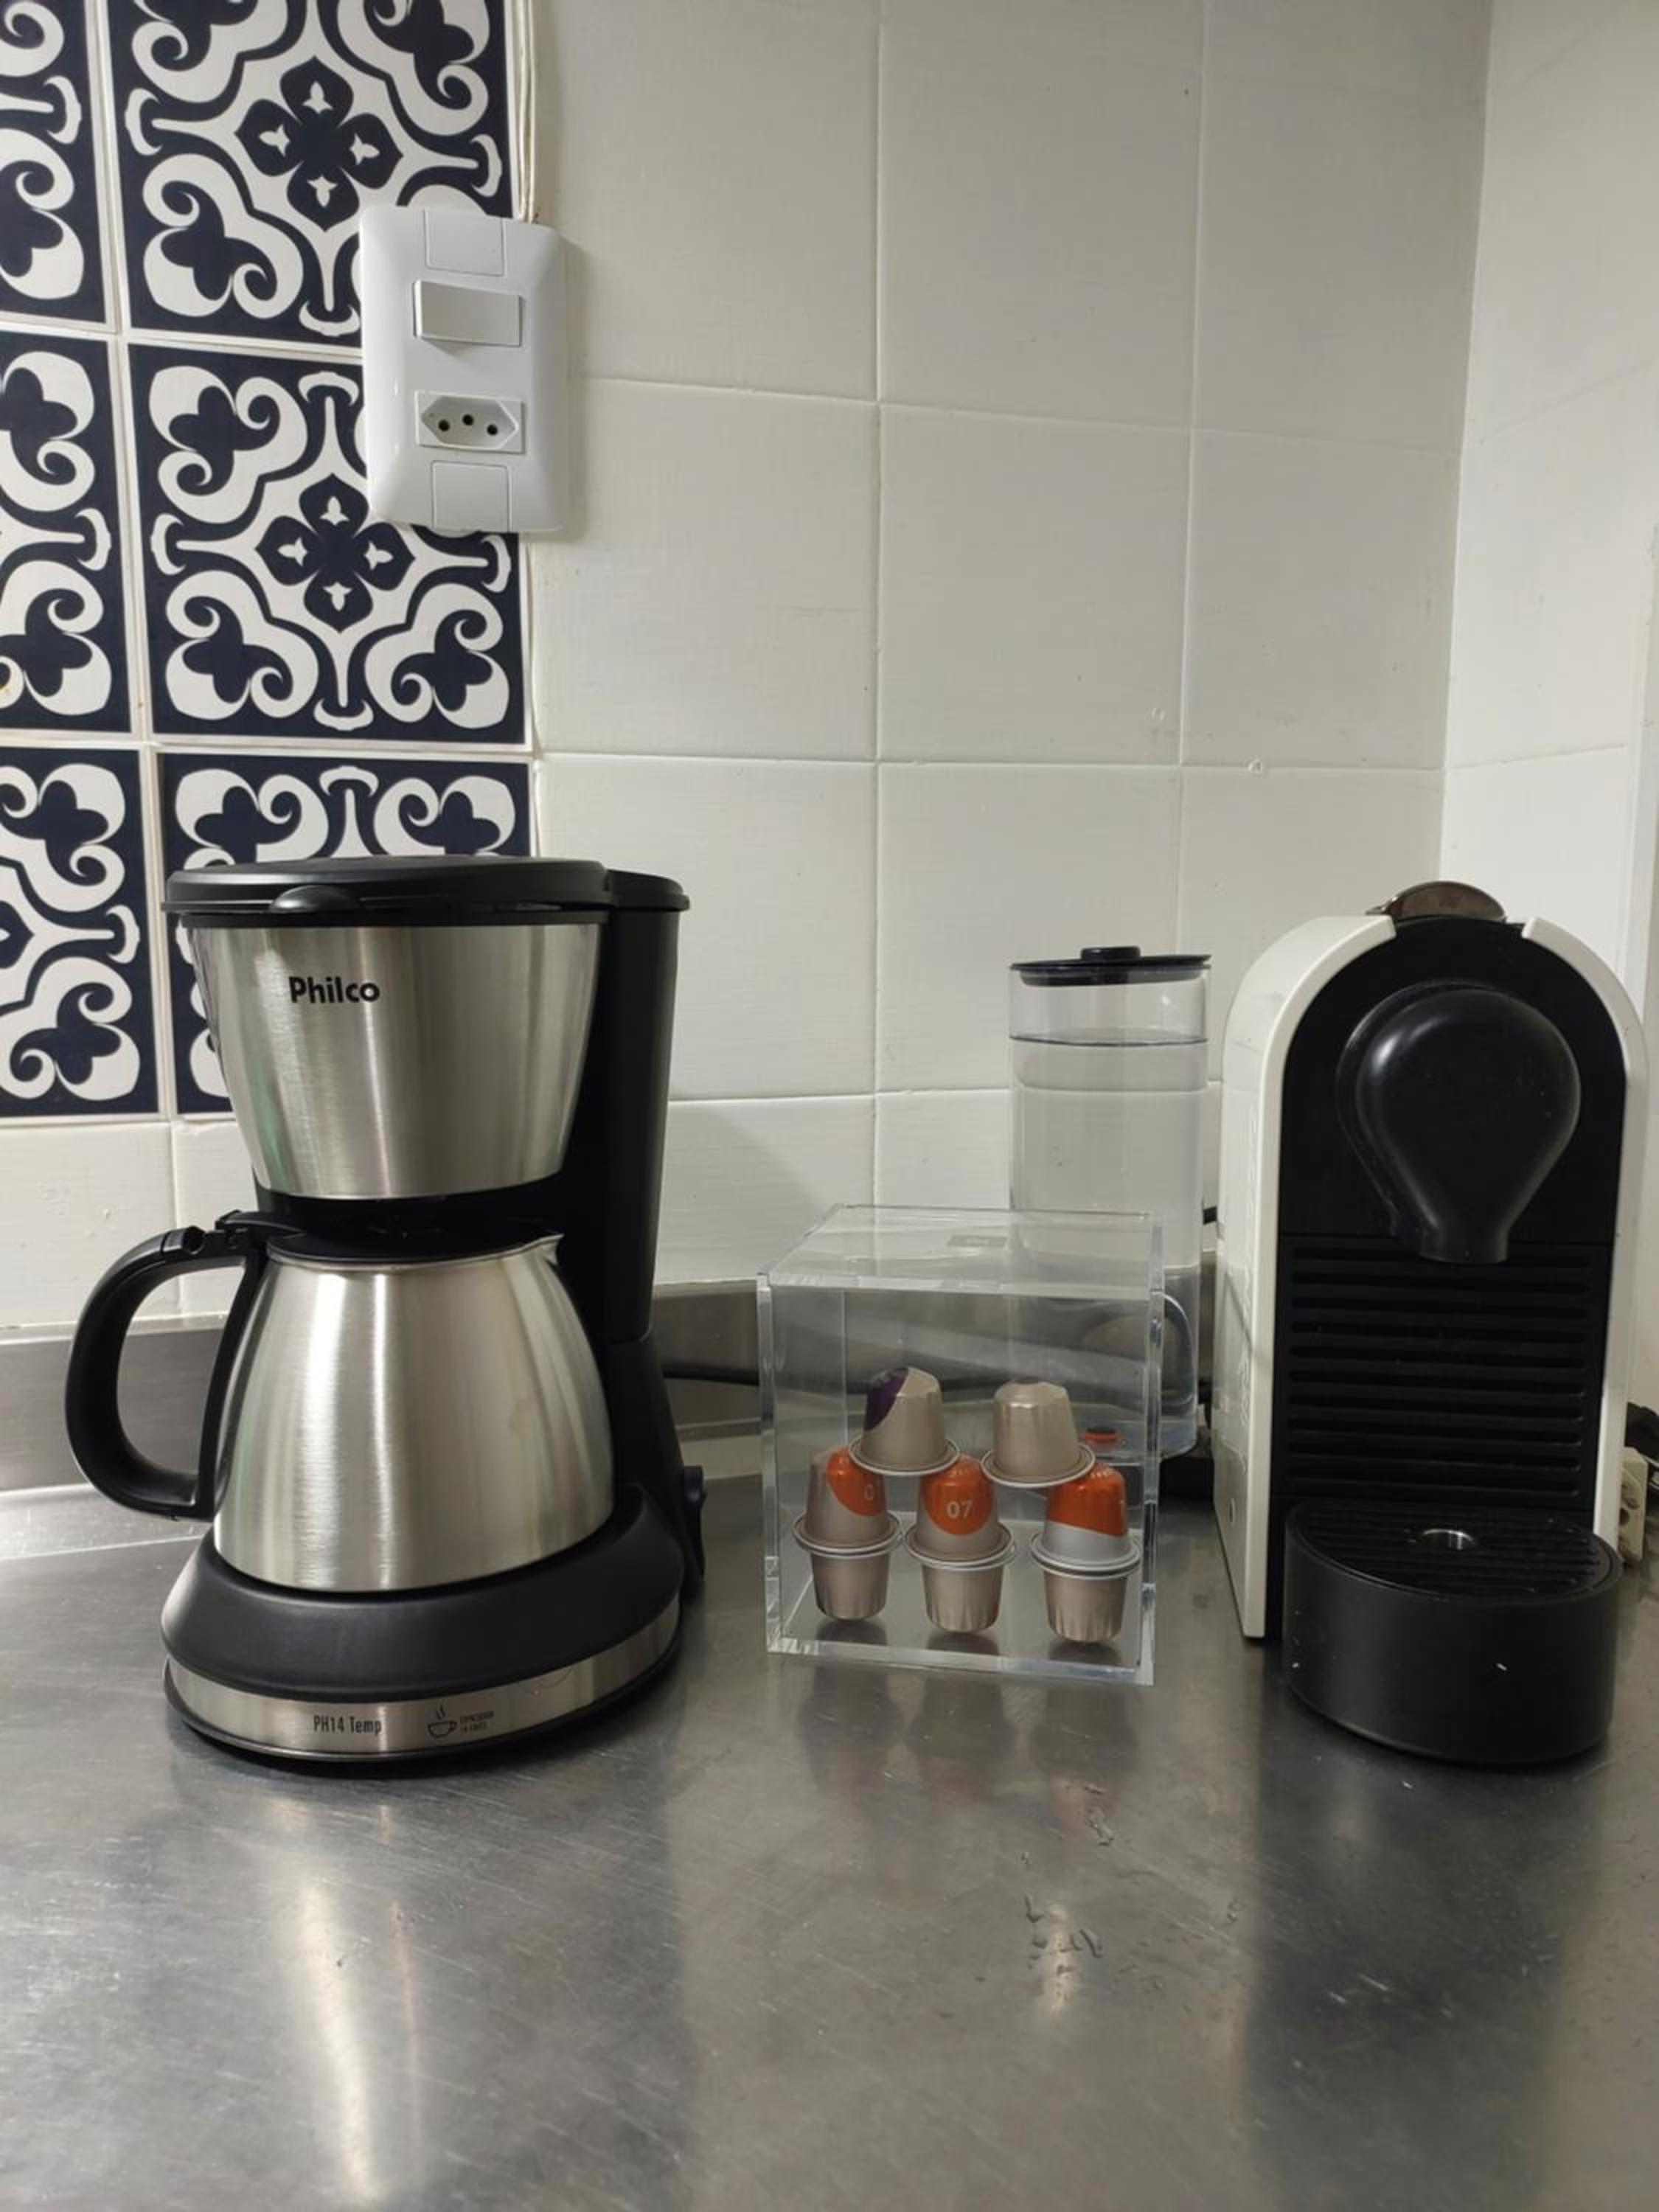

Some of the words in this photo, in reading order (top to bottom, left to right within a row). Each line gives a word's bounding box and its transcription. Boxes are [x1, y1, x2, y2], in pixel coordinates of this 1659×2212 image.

[288, 976, 380, 1004] Philco
[946, 1500, 973, 1519] 07
[313, 1715, 344, 1733] PH14
[349, 1716, 382, 1736] Temp
